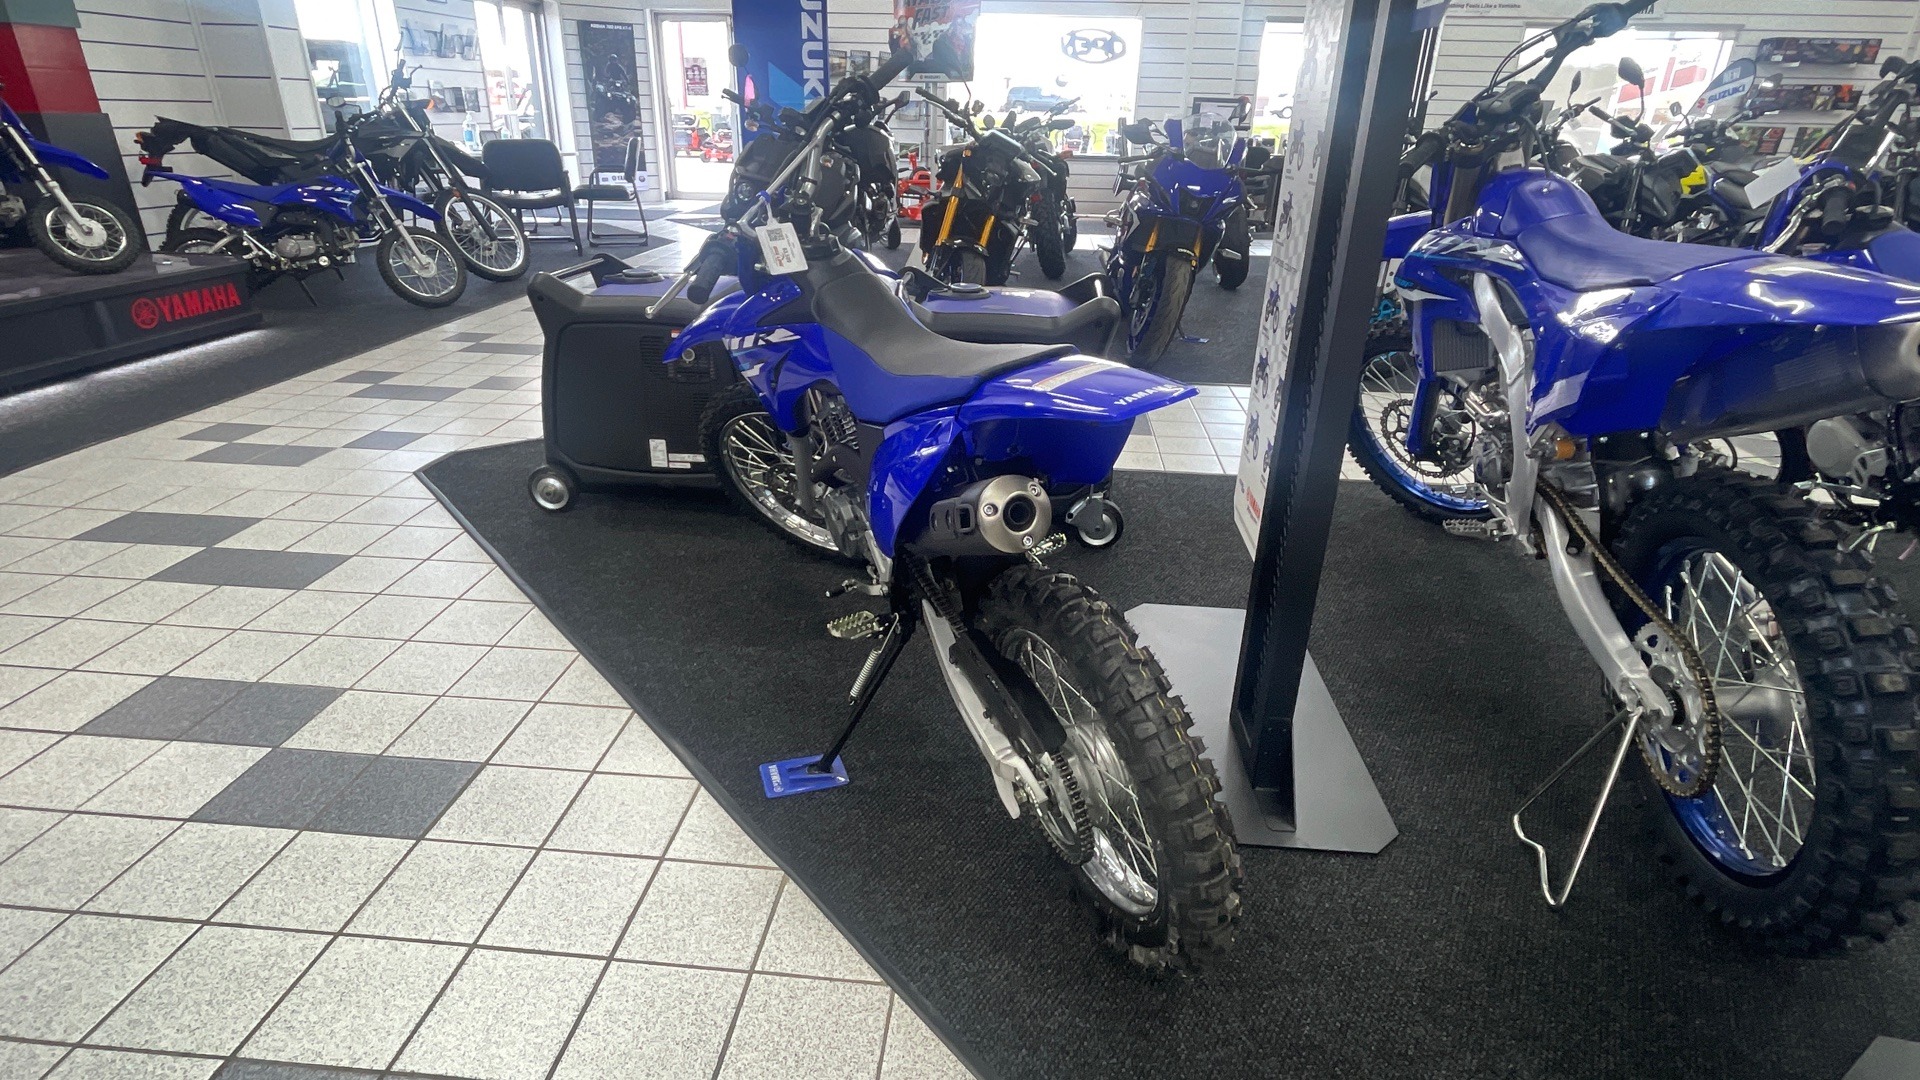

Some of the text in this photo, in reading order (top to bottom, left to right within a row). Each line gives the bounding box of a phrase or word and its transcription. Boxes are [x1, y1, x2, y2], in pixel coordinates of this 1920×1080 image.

[800, 0, 825, 109] ZUK
[1707, 84, 1746, 104] SUZUKI
[156, 282, 241, 322] YAMAHA
